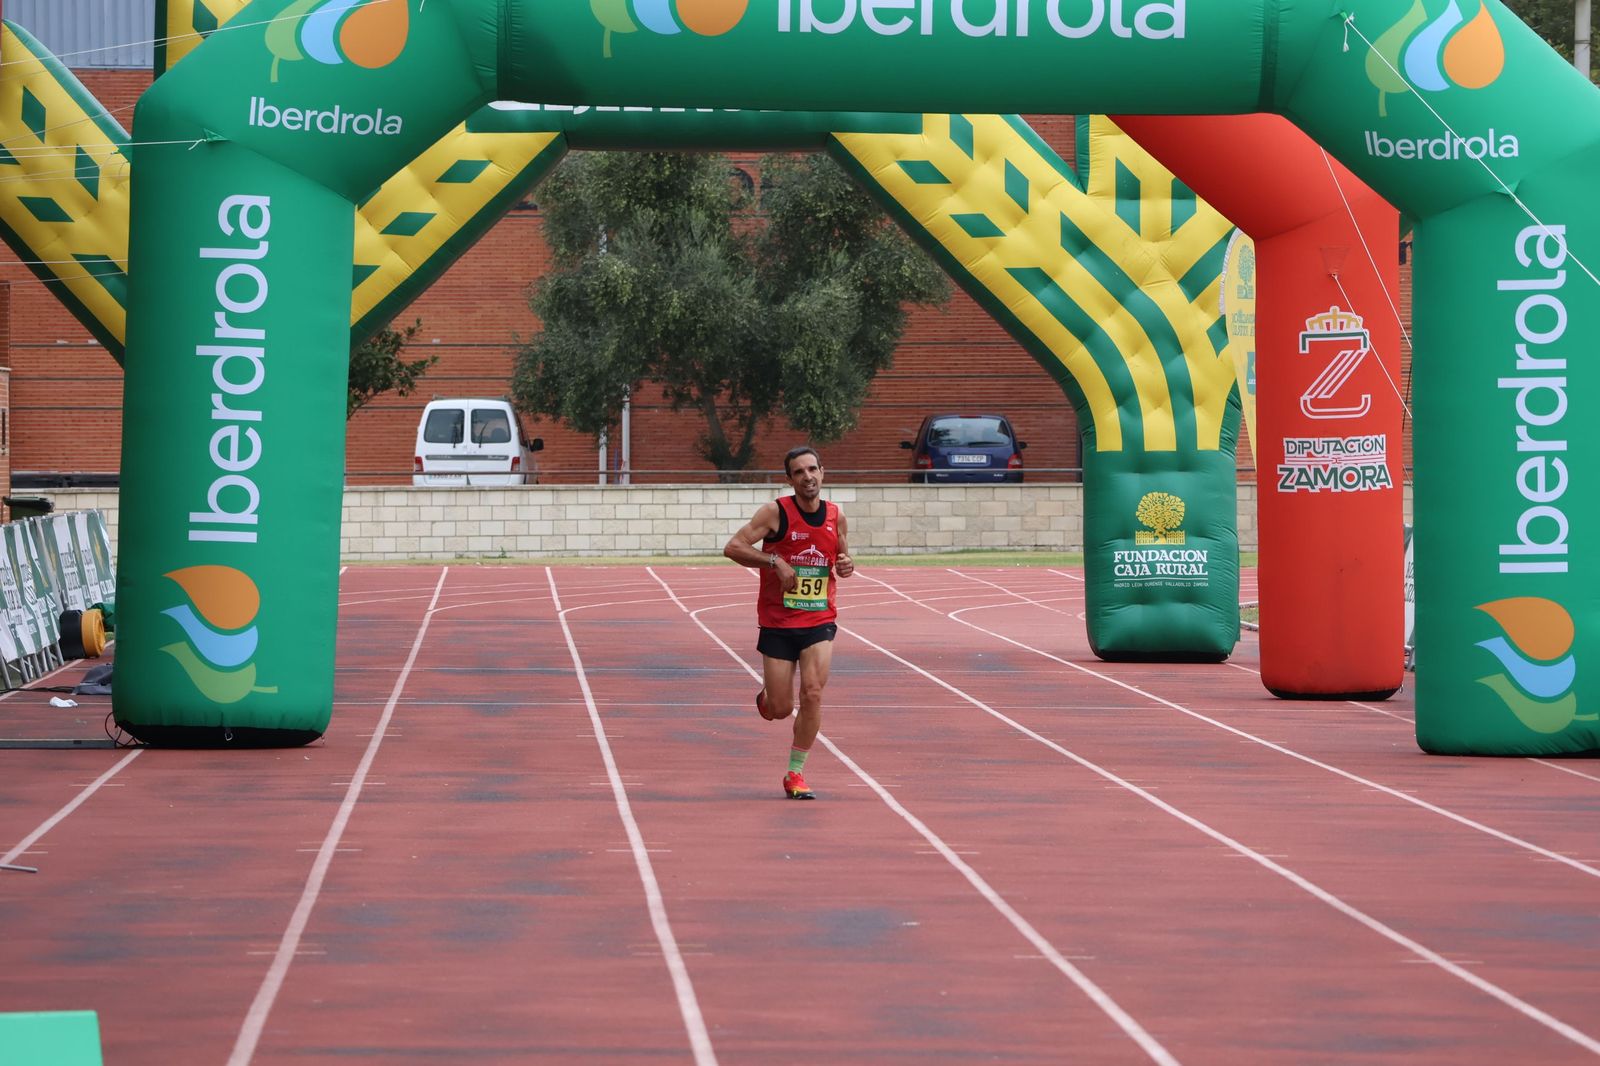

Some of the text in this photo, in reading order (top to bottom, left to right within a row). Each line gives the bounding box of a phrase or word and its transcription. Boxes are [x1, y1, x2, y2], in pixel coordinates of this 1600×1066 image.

[249, 96, 403, 135] Iberdrola
[1364, 128, 1519, 160] Iberdrola
[188, 194, 271, 543] Iberdrola
[1496, 224, 1569, 573] Iberdrola
[1278, 464, 1392, 491] ZAMORA
[1113, 549, 1208, 563] FUNDACION
[1114, 563, 1208, 577] CAJA RURAL
